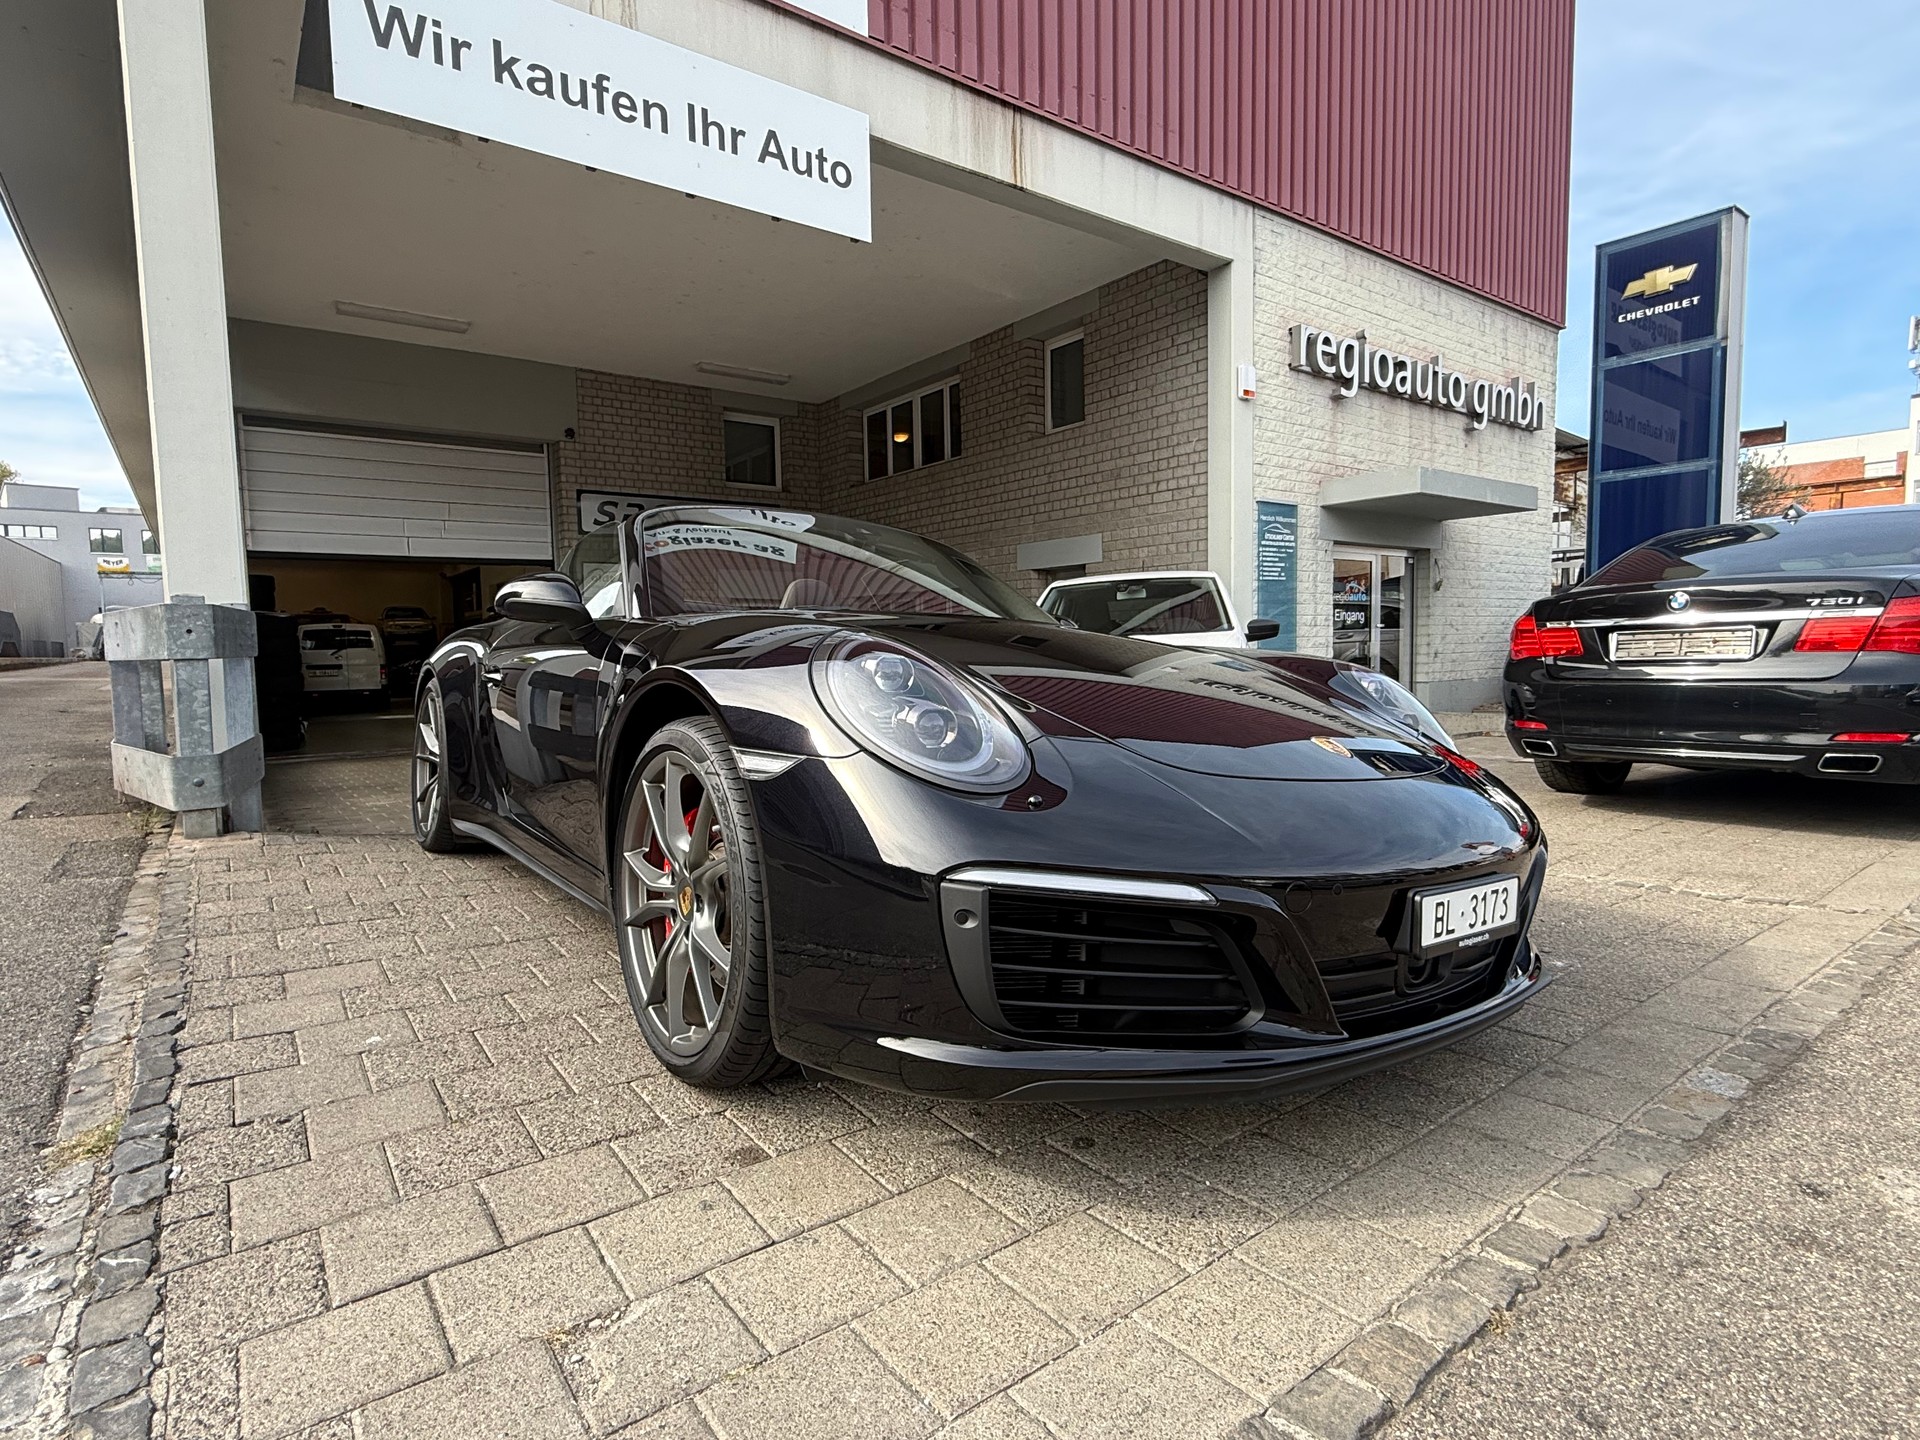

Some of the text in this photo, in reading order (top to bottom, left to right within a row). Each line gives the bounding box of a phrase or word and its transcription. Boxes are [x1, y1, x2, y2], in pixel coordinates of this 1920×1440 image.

[363, 0, 854, 190] Wir kaufen Ihr Auto
[1617, 295, 1701, 323] CHEVROLET
[1294, 324, 1545, 431] regioauto gmbh
[1334, 609, 1365, 624] Eingang
[1433, 886, 1509, 939] BL 3173
